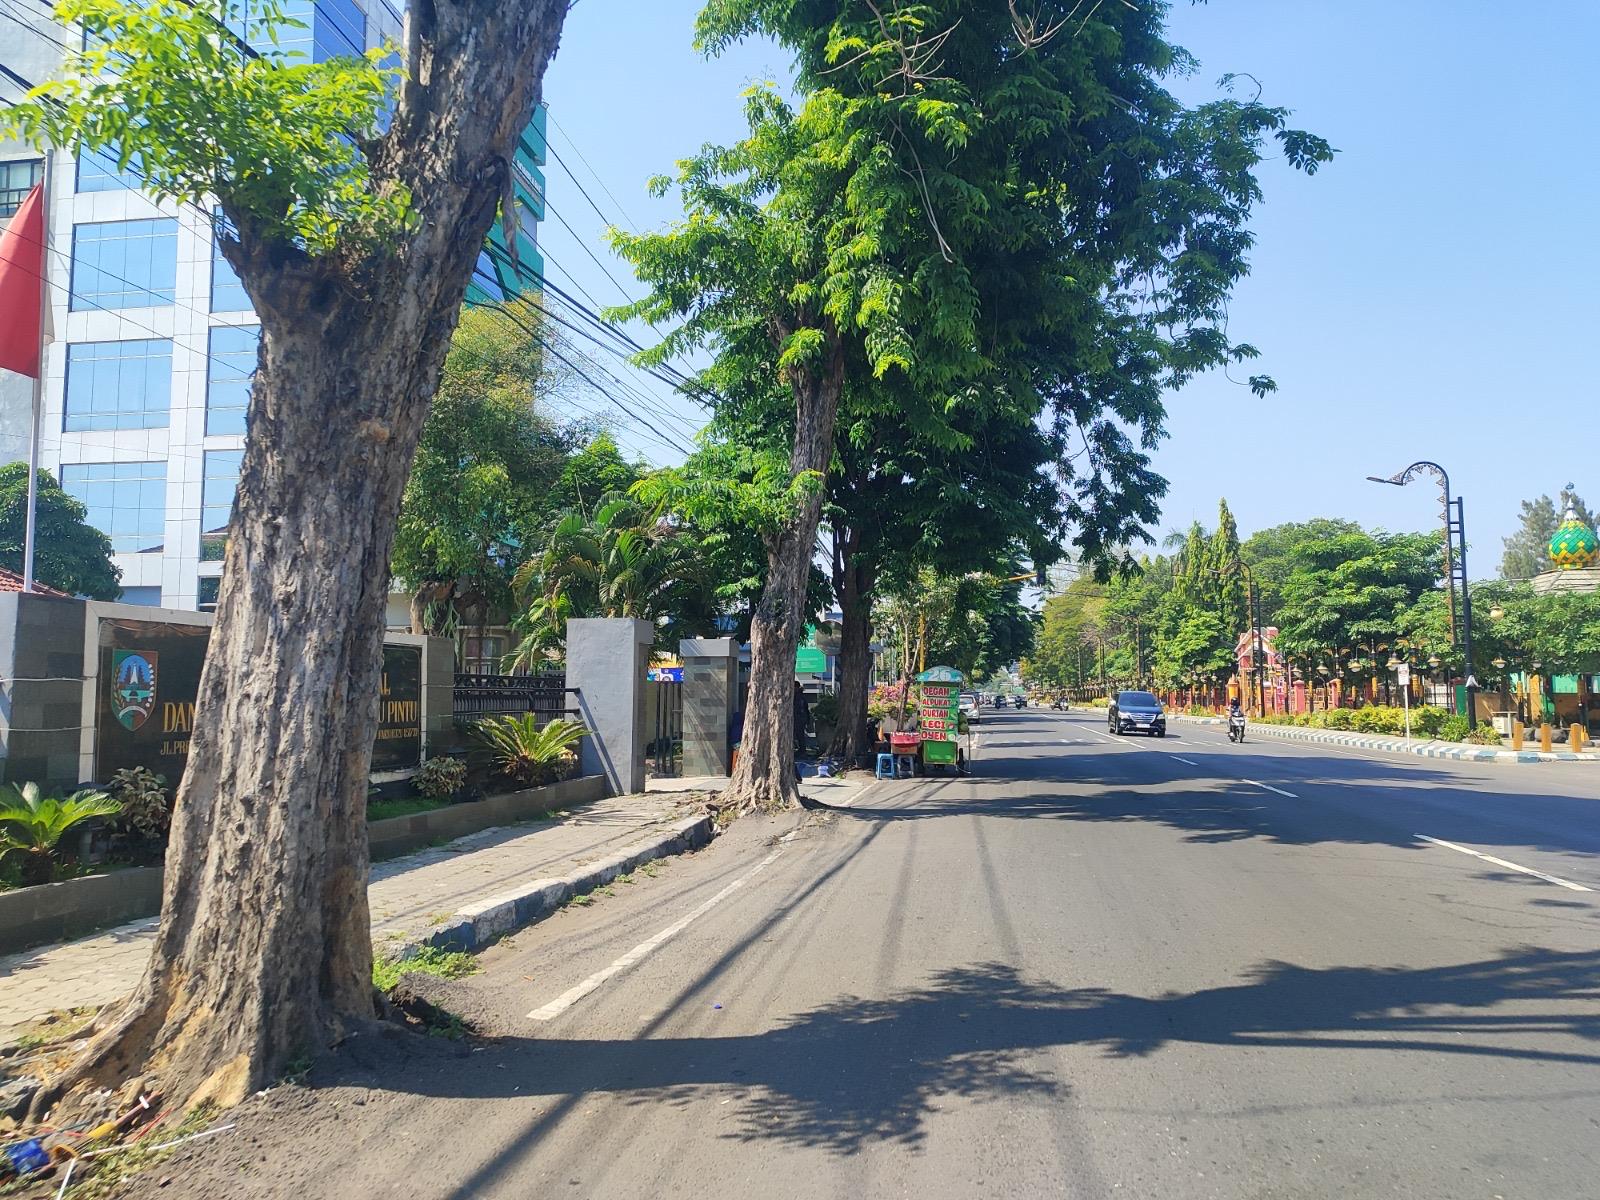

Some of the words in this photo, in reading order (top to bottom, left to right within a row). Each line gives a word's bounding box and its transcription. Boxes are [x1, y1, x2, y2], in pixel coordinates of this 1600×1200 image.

[387, 700, 417, 723] PINTU
[921, 709, 949, 718] DURIAN
[921, 720, 946, 729] LECI
[920, 730, 947, 740] OYEN
